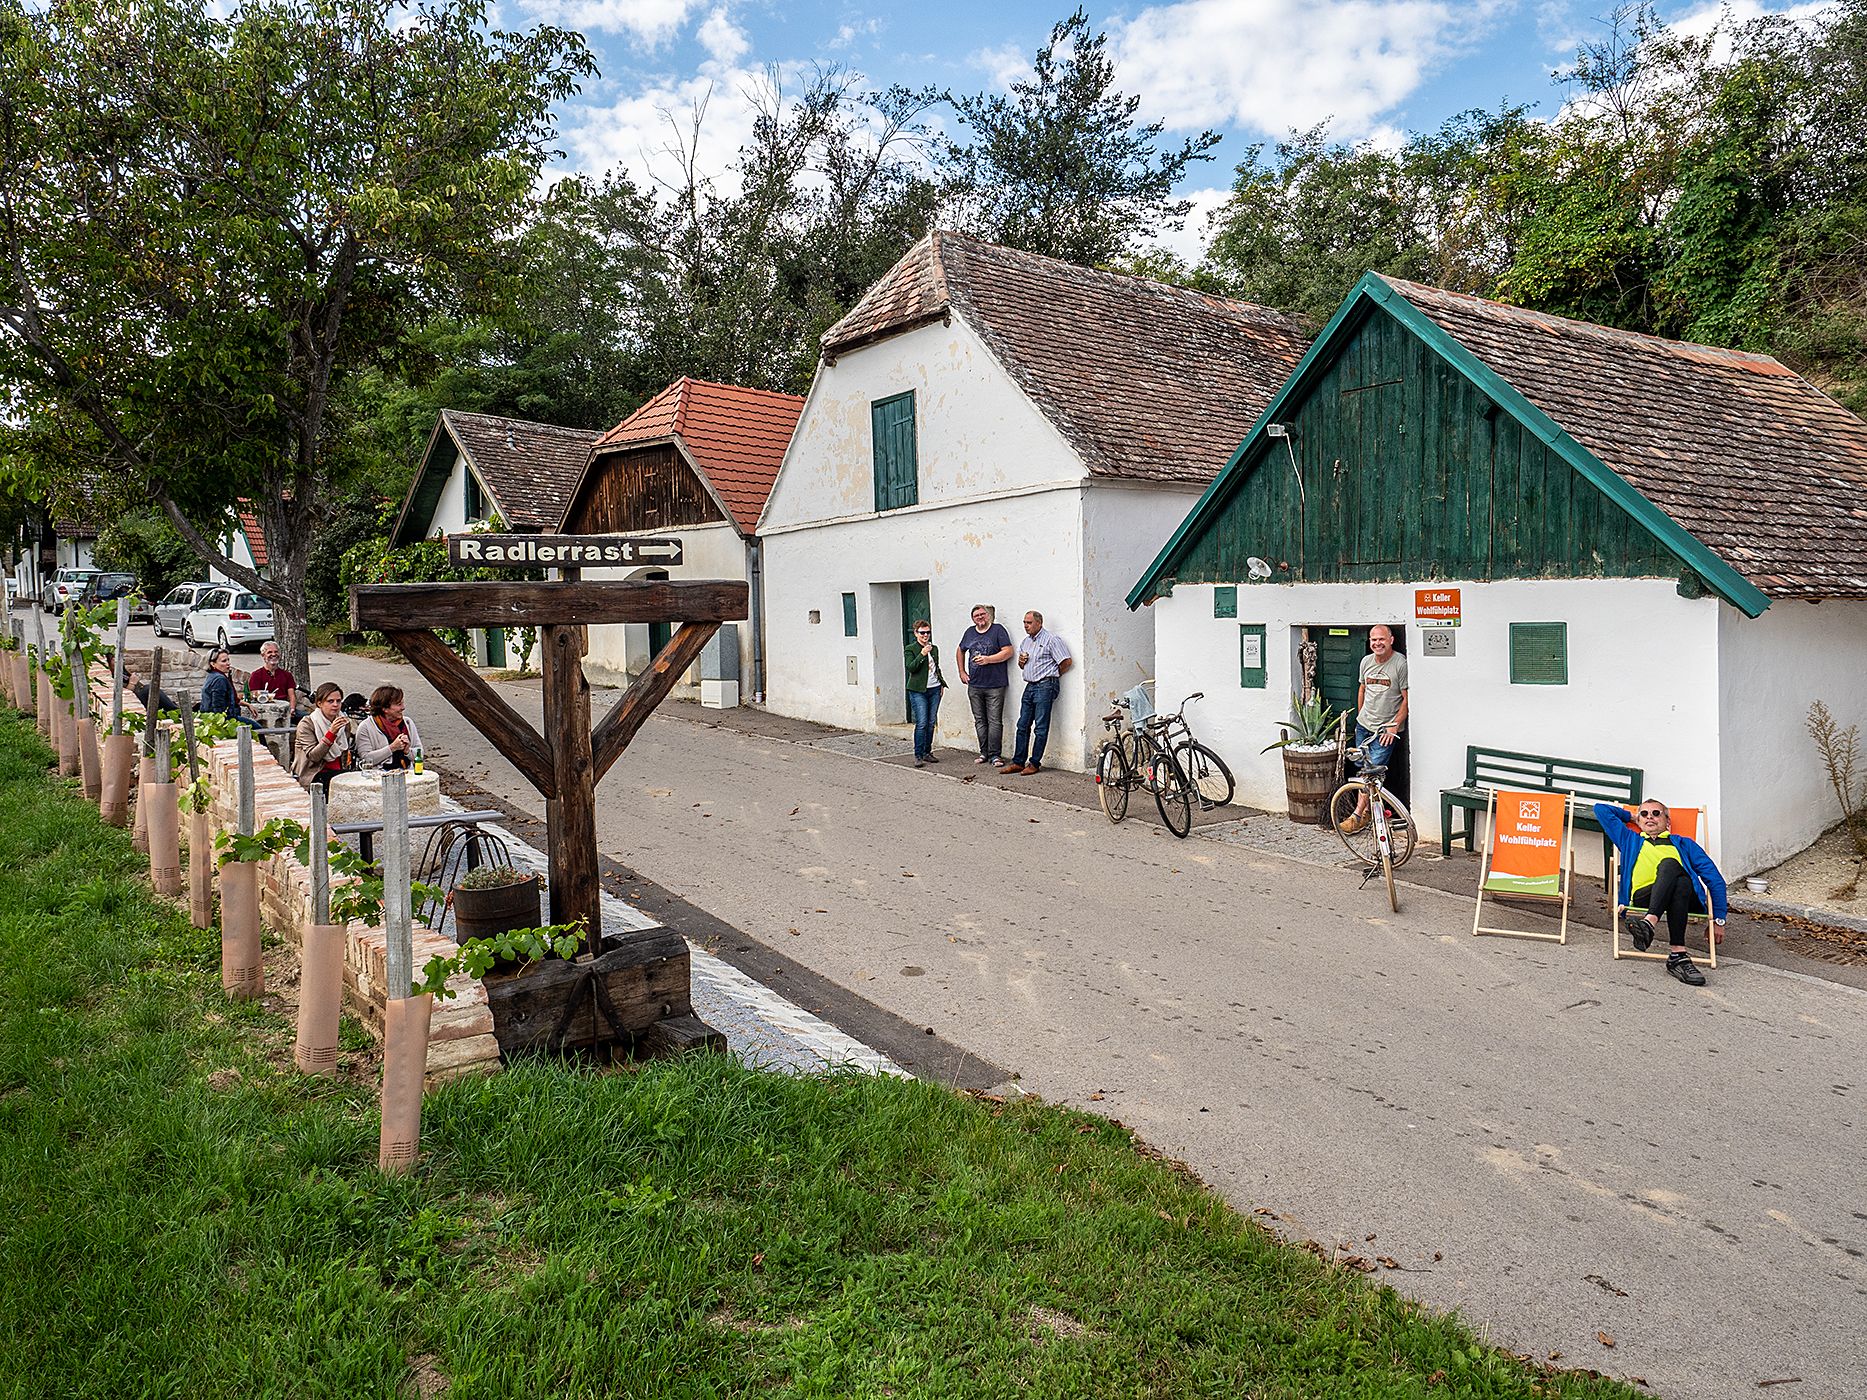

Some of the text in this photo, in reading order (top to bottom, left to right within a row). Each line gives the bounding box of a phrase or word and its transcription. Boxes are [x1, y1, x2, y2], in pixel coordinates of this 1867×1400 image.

[459, 540, 633, 561] Radlerrast
[1432, 593, 1451, 602] Keller
[1417, 606, 1459, 616] Wohlfühlplatz
[1516, 822, 1541, 832] Keller
[1499, 834, 1557, 847] Wohlfühlplatz
